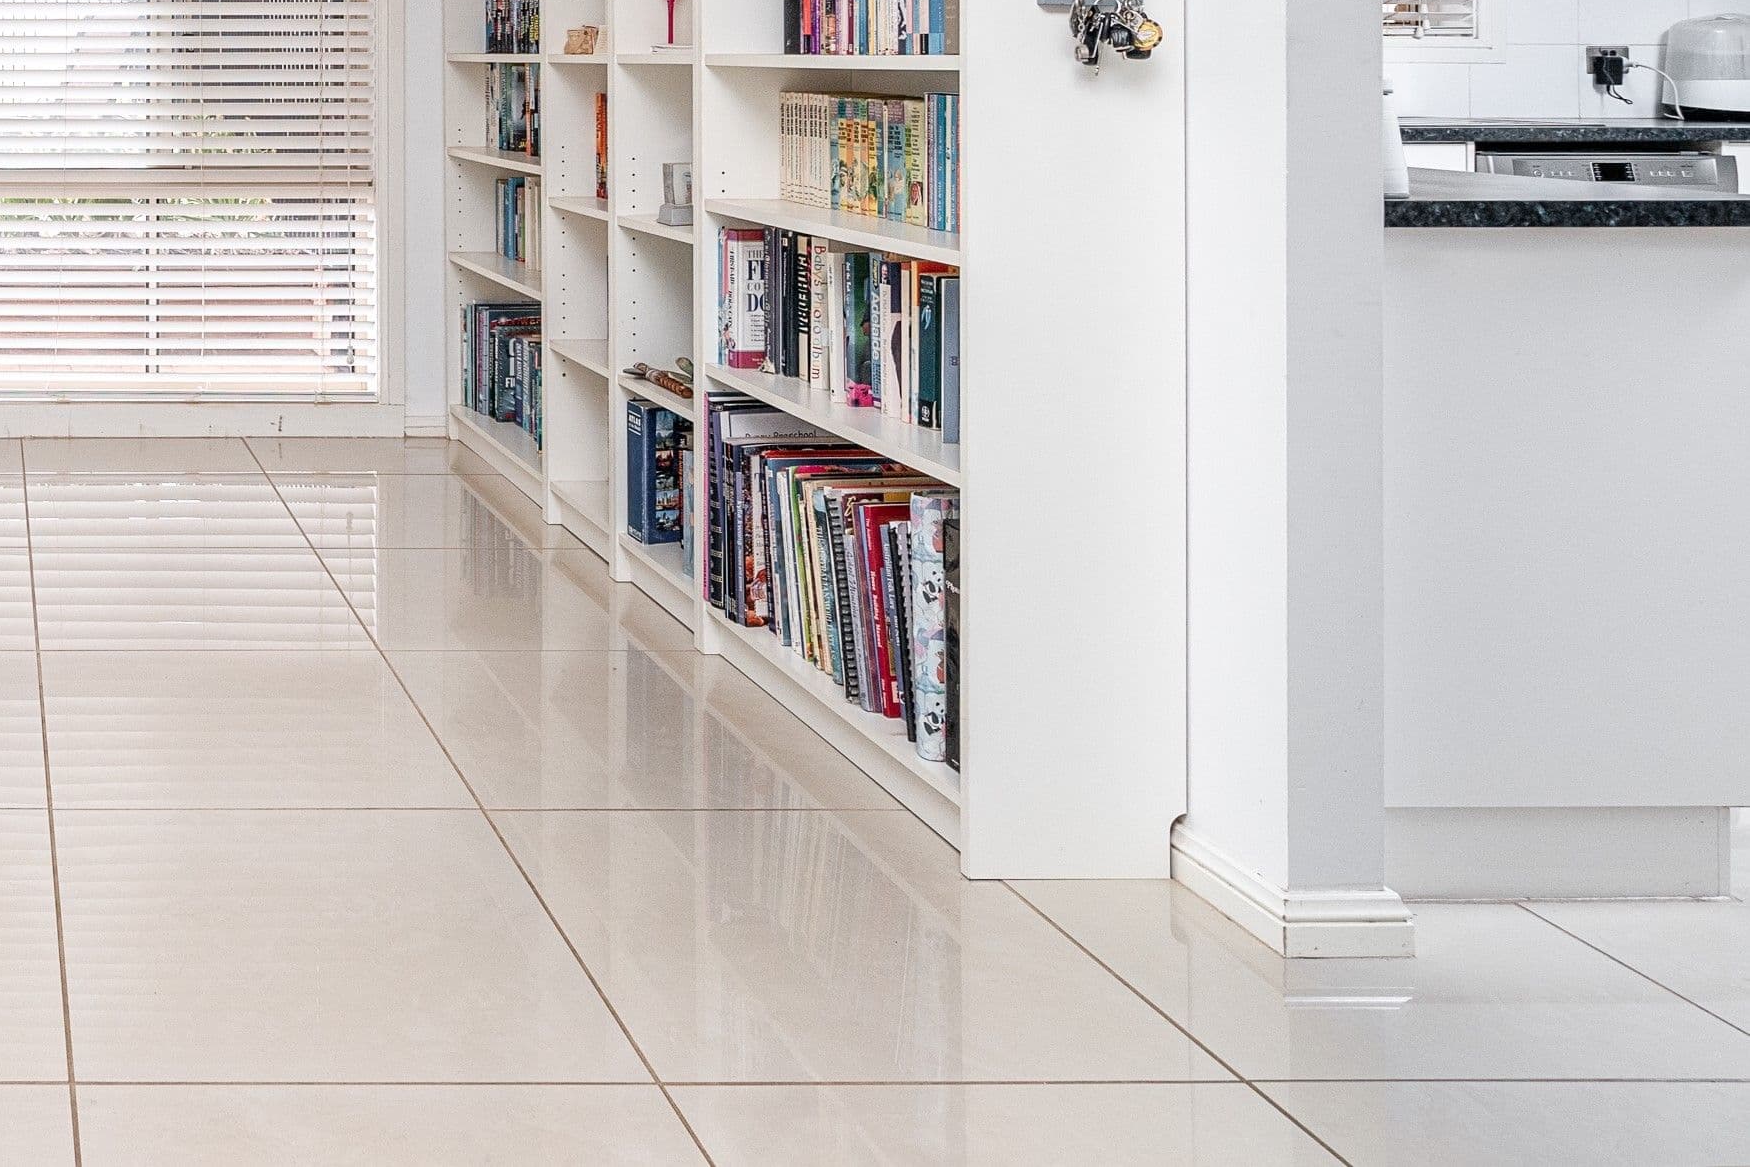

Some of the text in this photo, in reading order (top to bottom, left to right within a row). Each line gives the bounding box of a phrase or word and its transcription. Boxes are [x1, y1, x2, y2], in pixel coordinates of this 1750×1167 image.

[812, 246, 826, 380] Baby's Photo album
[871, 292, 880, 361] Adelaide
[628, 414, 641, 427] ATLAS
